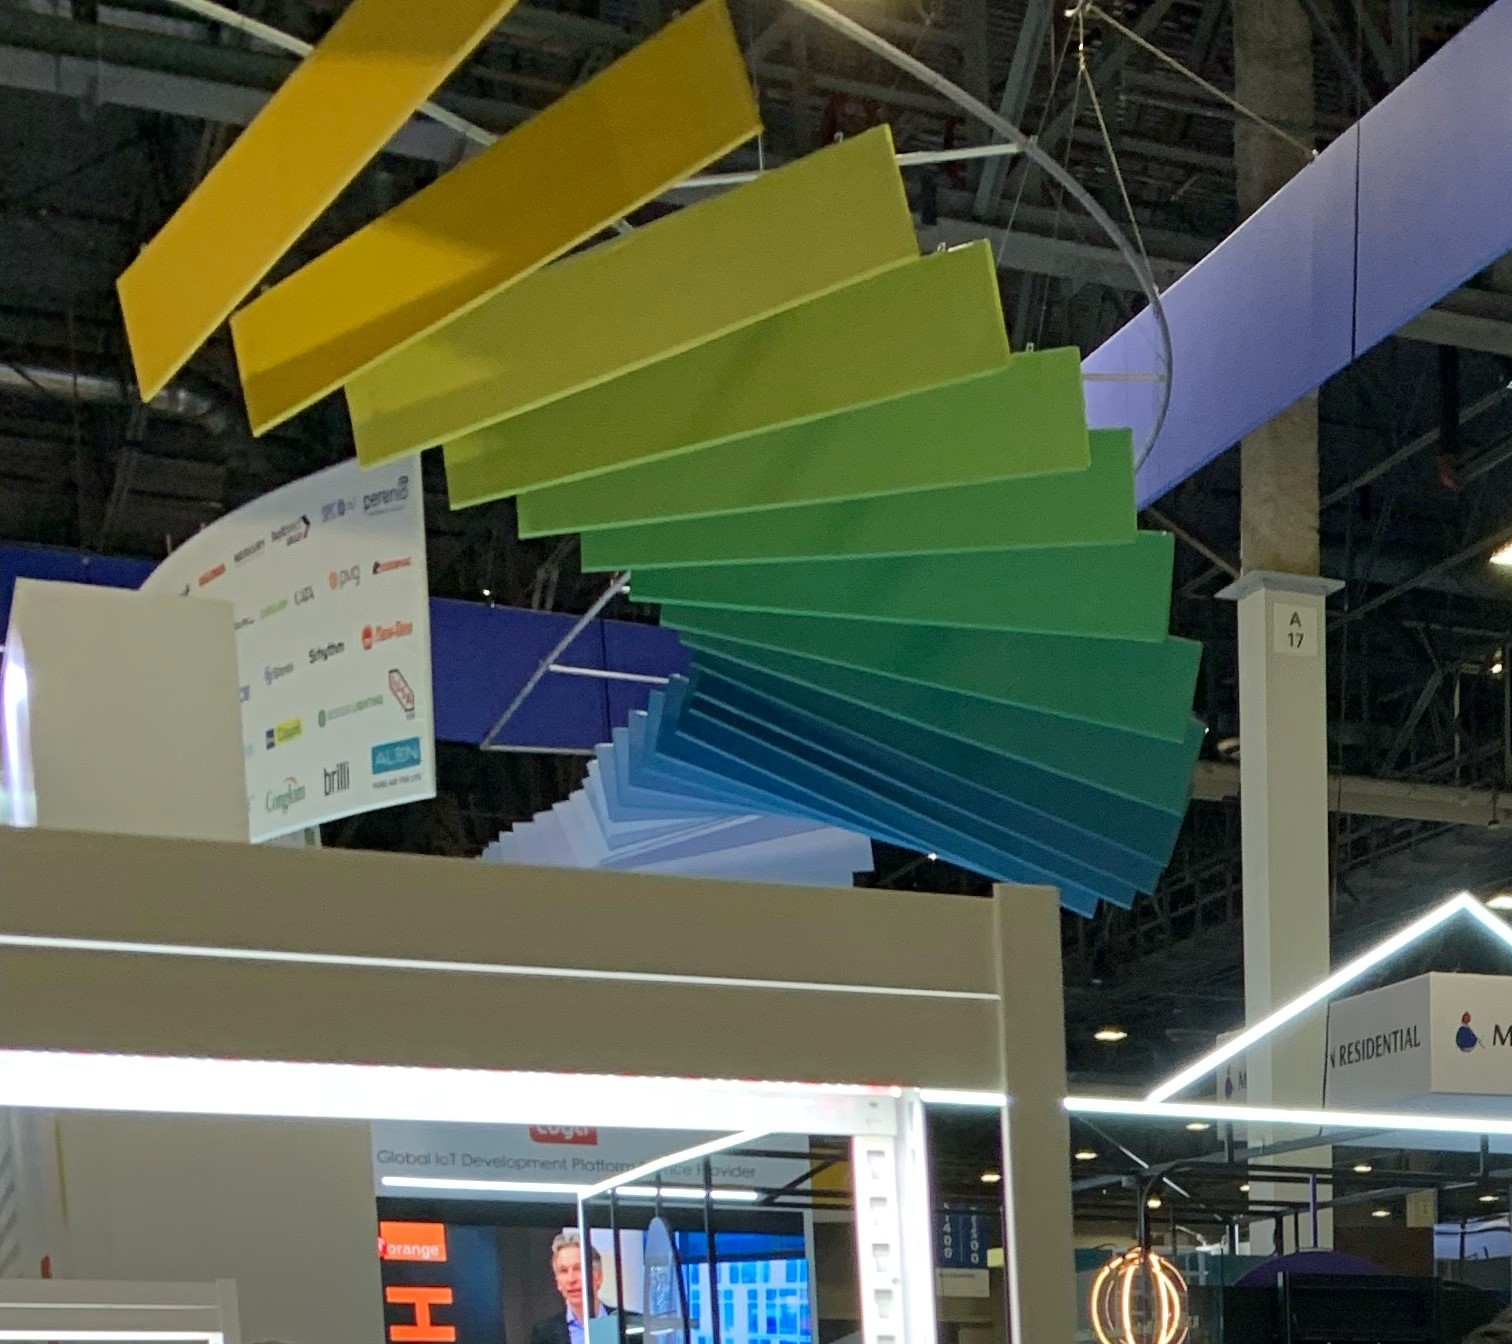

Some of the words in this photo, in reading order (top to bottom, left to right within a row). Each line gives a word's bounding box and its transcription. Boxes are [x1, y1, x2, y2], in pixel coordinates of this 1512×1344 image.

[1289, 611, 1302, 628] A
[1288, 631, 1304, 649] 17
[1339, 1025, 1421, 1068] RESIDENTIAL
[377, 1149, 431, 1166] Global
[462, 1154, 567, 1172] Development
[697, 1163, 756, 1179] ovider
[386, 1243, 440, 1260] orange
